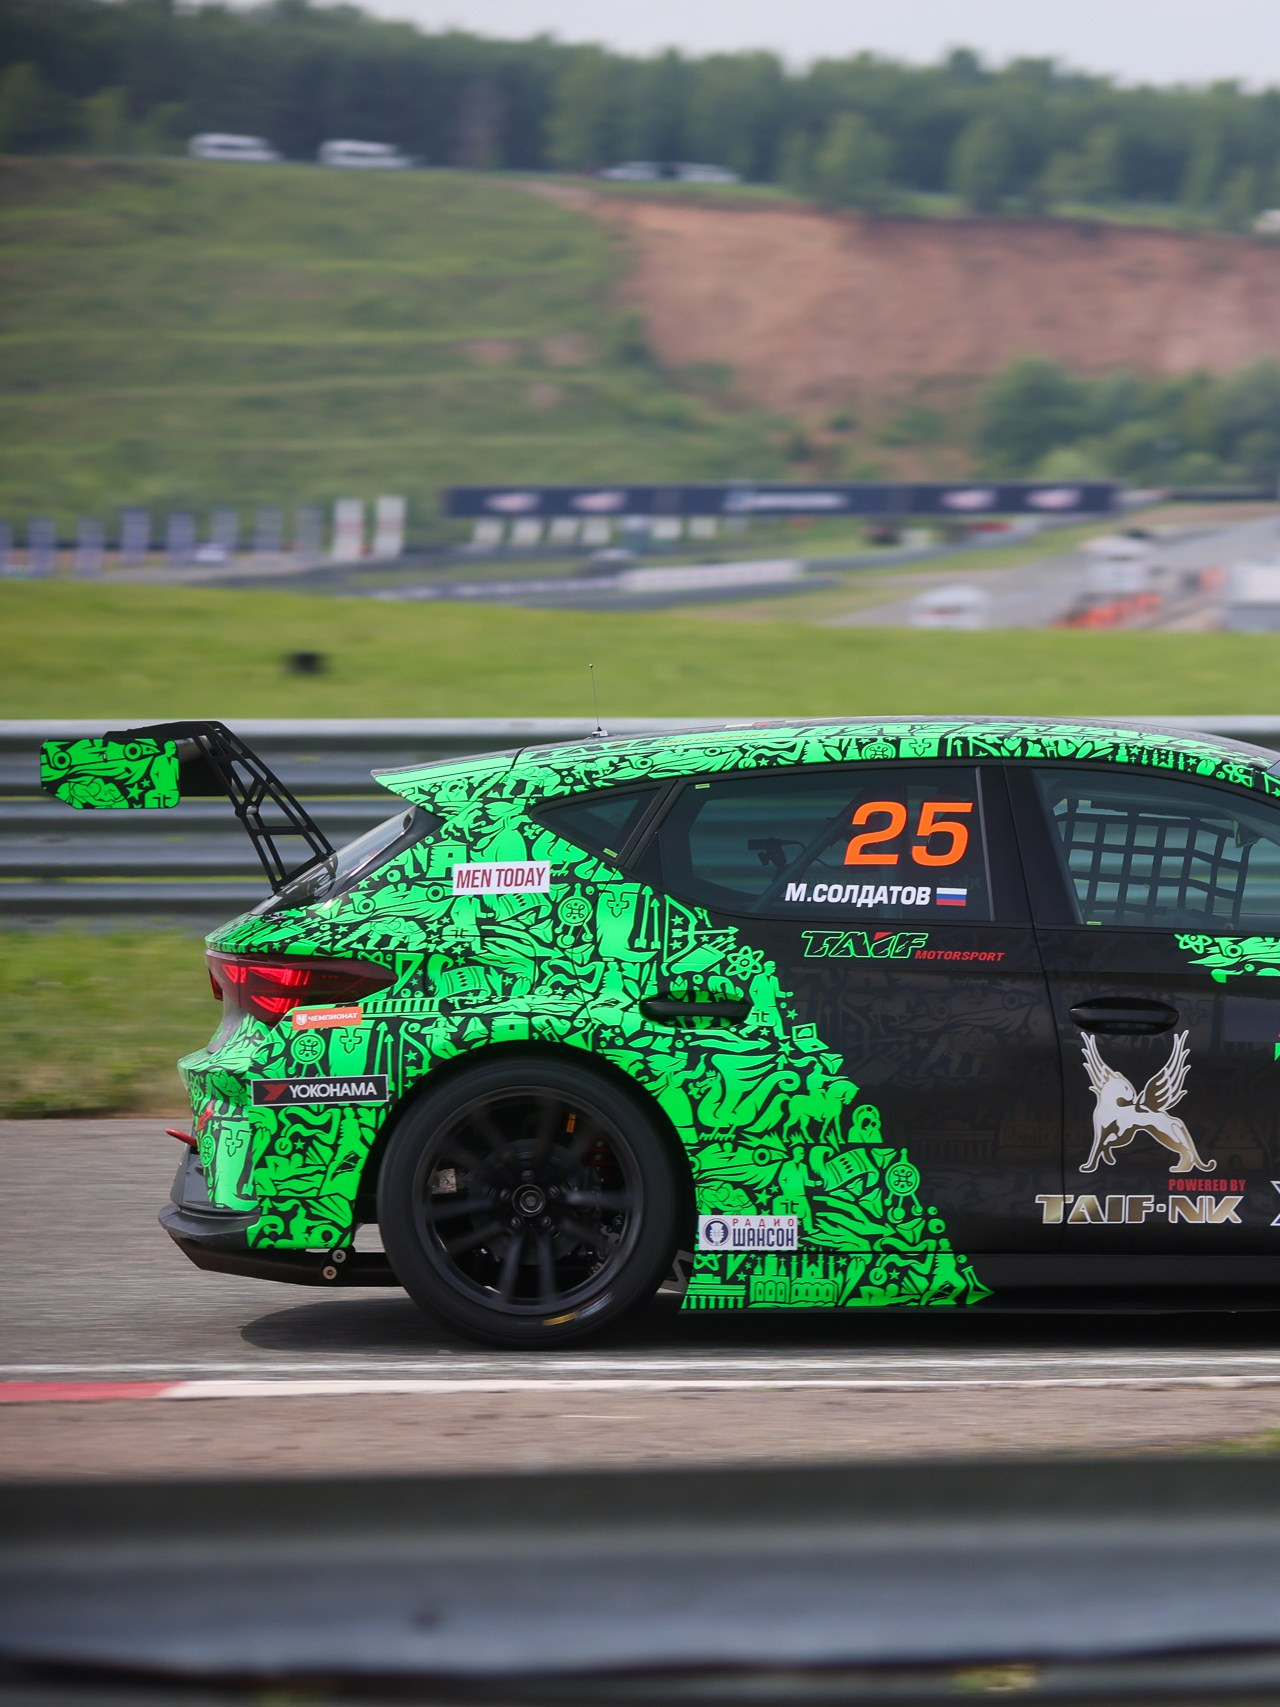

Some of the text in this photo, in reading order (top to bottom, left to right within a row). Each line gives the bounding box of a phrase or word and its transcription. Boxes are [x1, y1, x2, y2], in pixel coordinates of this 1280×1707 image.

[844, 801, 973, 867] 25
[456, 867, 546, 889] MEN TODAY
[785, 882, 931, 908] М.СОЛДАТОВ
[914, 950, 1005, 962] MOTORSPORT
[307, 1012, 359, 1022] ЧЕМПИОНАТ
[289, 1081, 377, 1099] YOKOHAMA
[1168, 1179, 1246, 1191] POWERED BY
[732, 1218, 794, 1227] РАДИО
[733, 1228, 794, 1247] ШАНСОН
